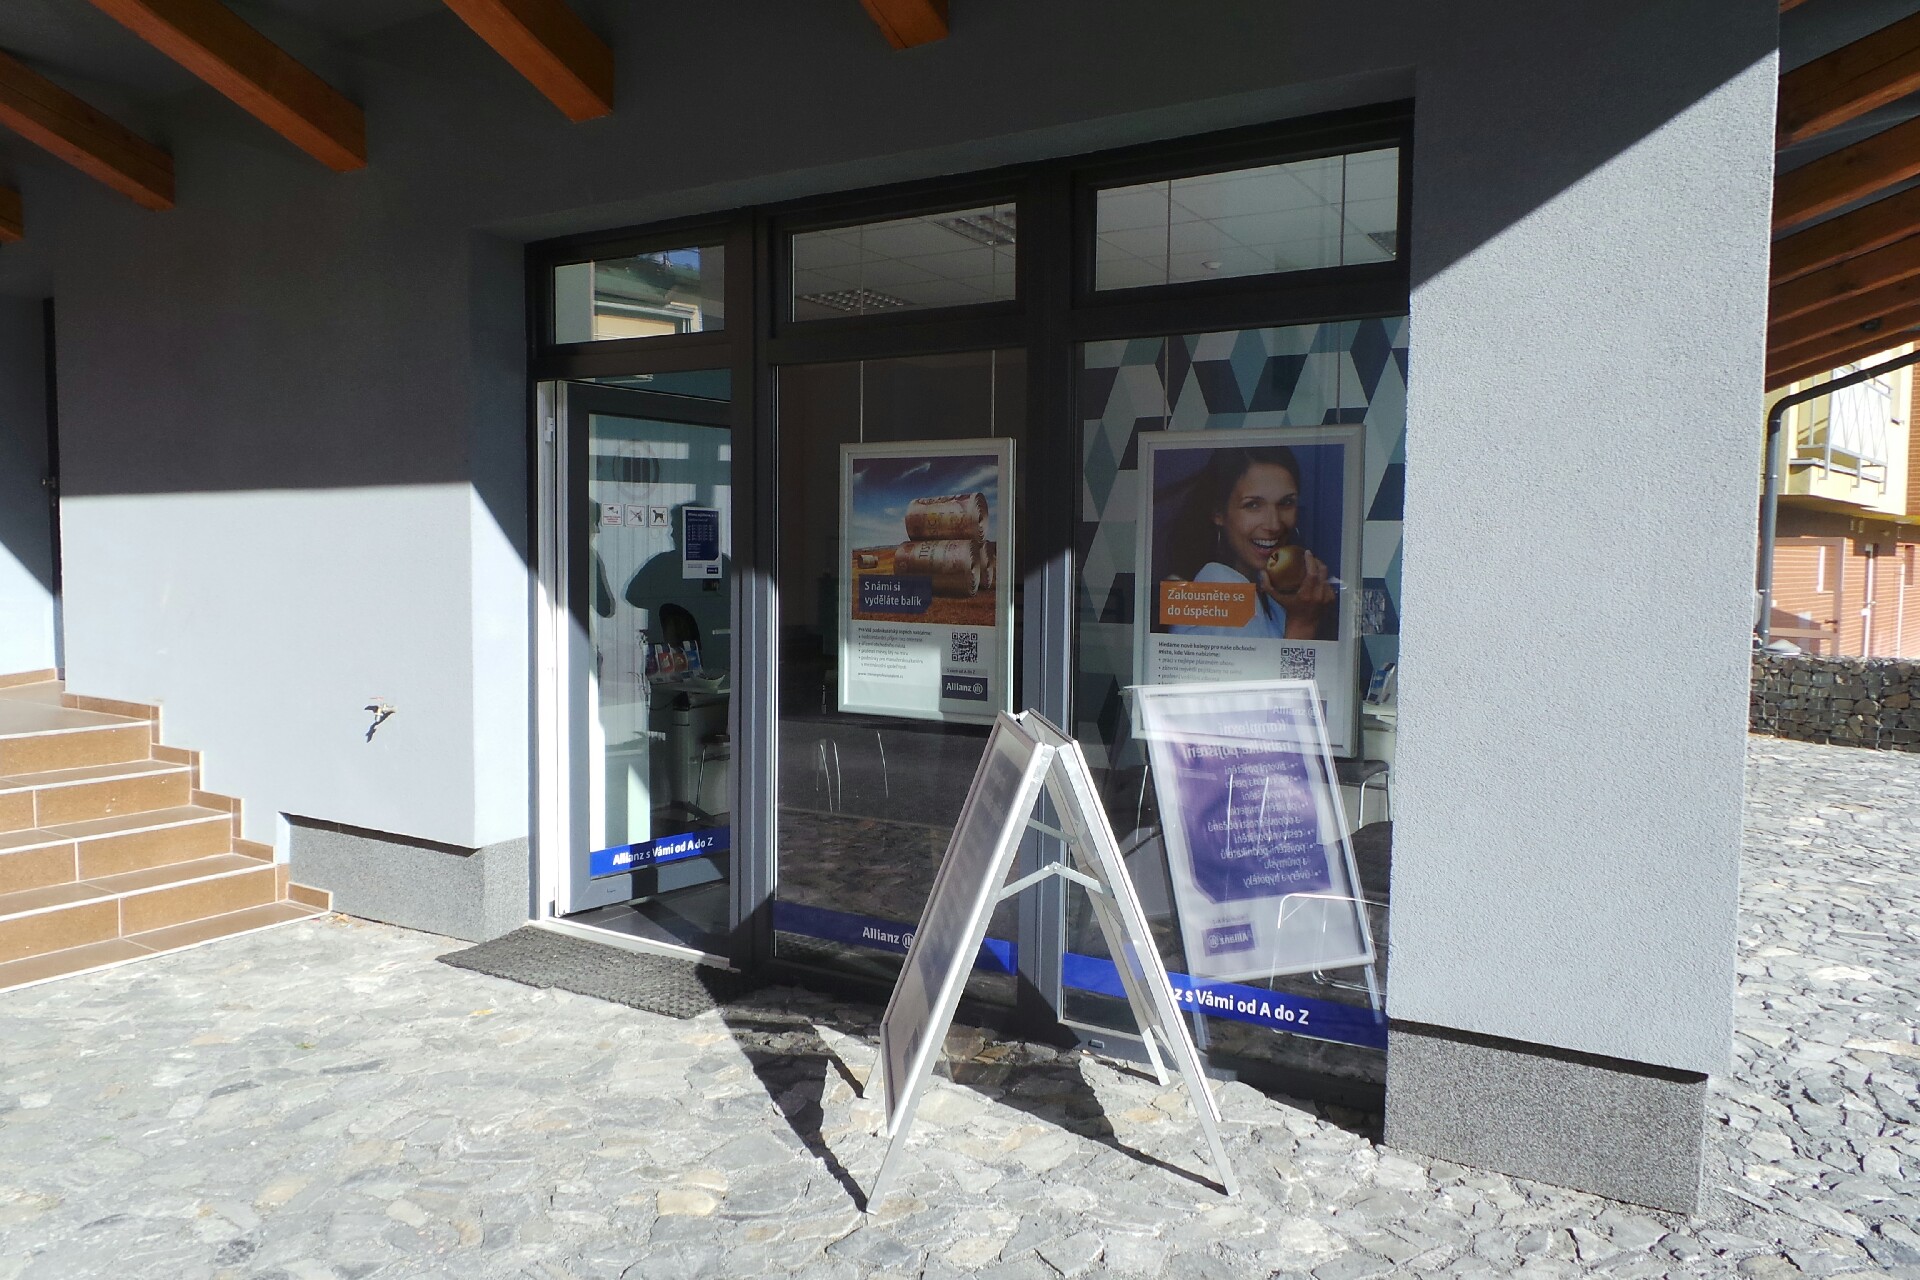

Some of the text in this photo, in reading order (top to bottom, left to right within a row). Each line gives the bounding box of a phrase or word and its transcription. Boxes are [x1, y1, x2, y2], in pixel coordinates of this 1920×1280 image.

[864, 581, 900, 591] S námi si
[864, 594, 921, 607] vyděláte balík
[1167, 589, 1245, 602] Zakousněte se
[1167, 605, 1229, 618] do úspěchu
[946, 682, 972, 692] Allianz
[613, 836, 713, 866] Allianz s Vámi od A do Z
[862, 926, 900, 944] Allianz
[1185, 990, 1193, 1002] s
[1196, 989, 1235, 1011] Vámi
[1237, 998, 1257, 1014] od
[1259, 1002, 1271, 1017] A
[1274, 1005, 1295, 1022] do
[1298, 1009, 1309, 1025] Z
